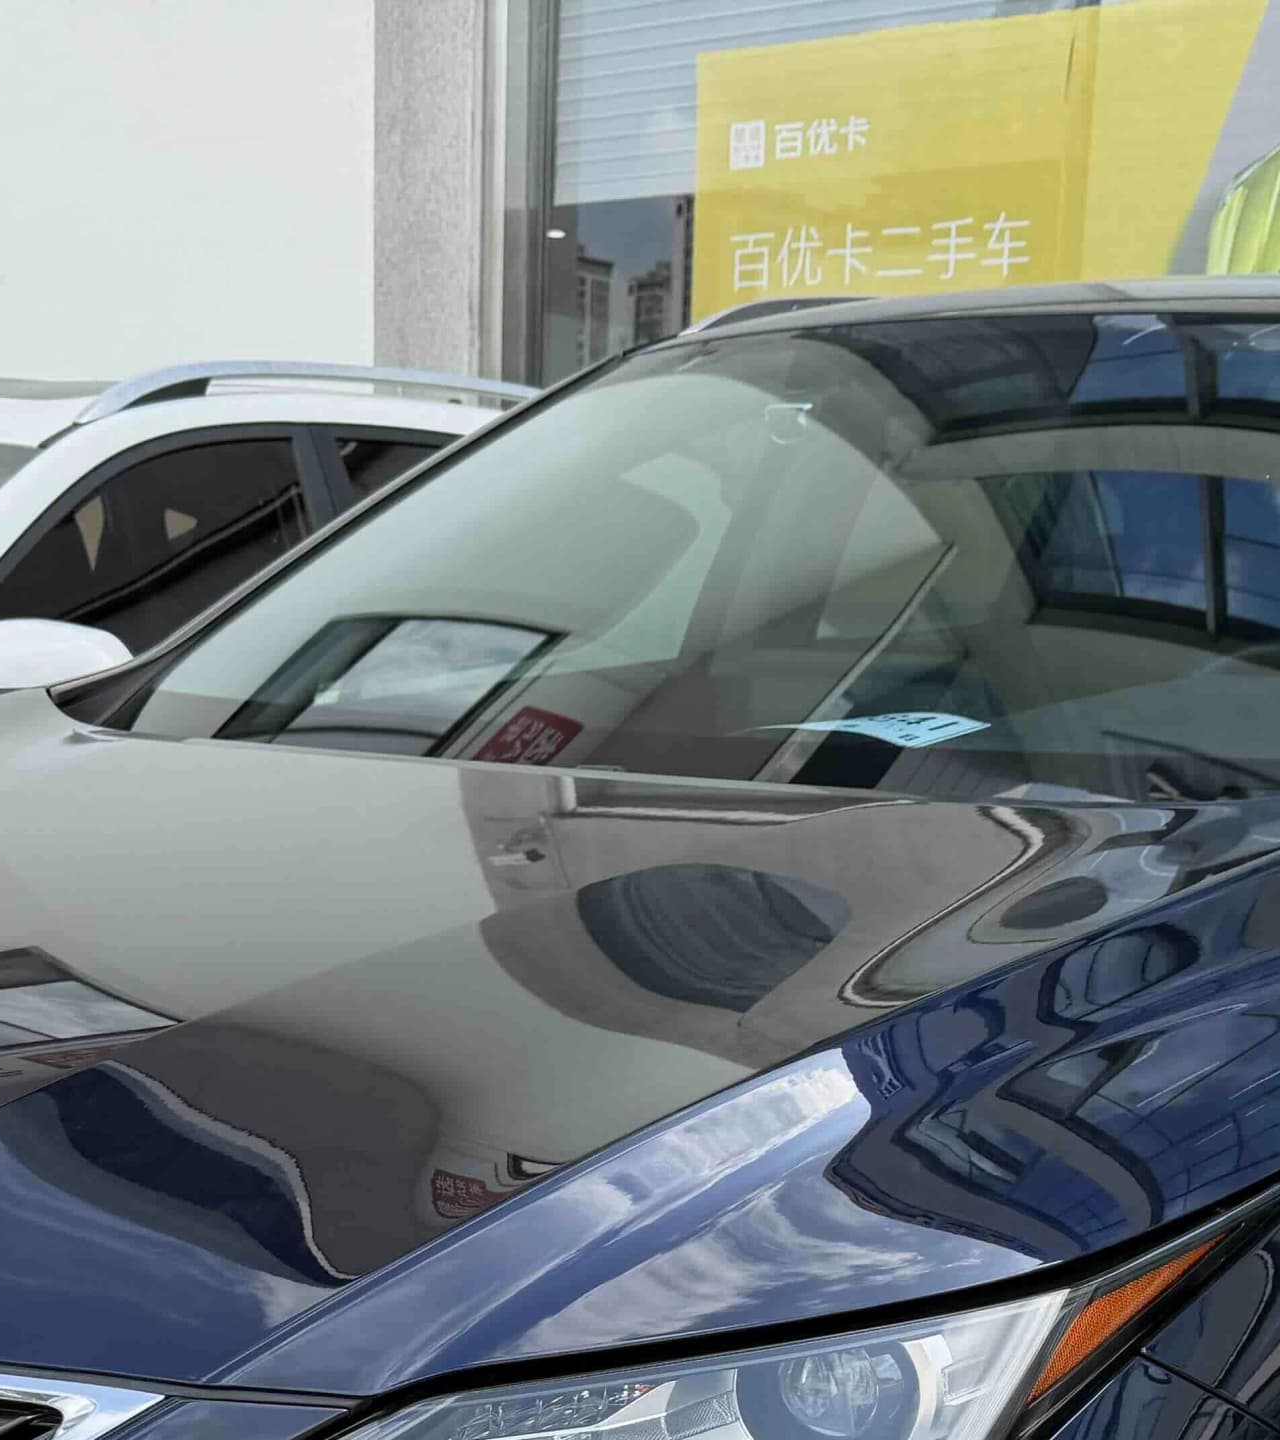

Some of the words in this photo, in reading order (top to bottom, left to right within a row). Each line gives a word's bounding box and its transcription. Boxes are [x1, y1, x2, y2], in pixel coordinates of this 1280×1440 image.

[774, 115, 870, 160] 百优卡
[730, 211, 1031, 291] 百优卡二手车
